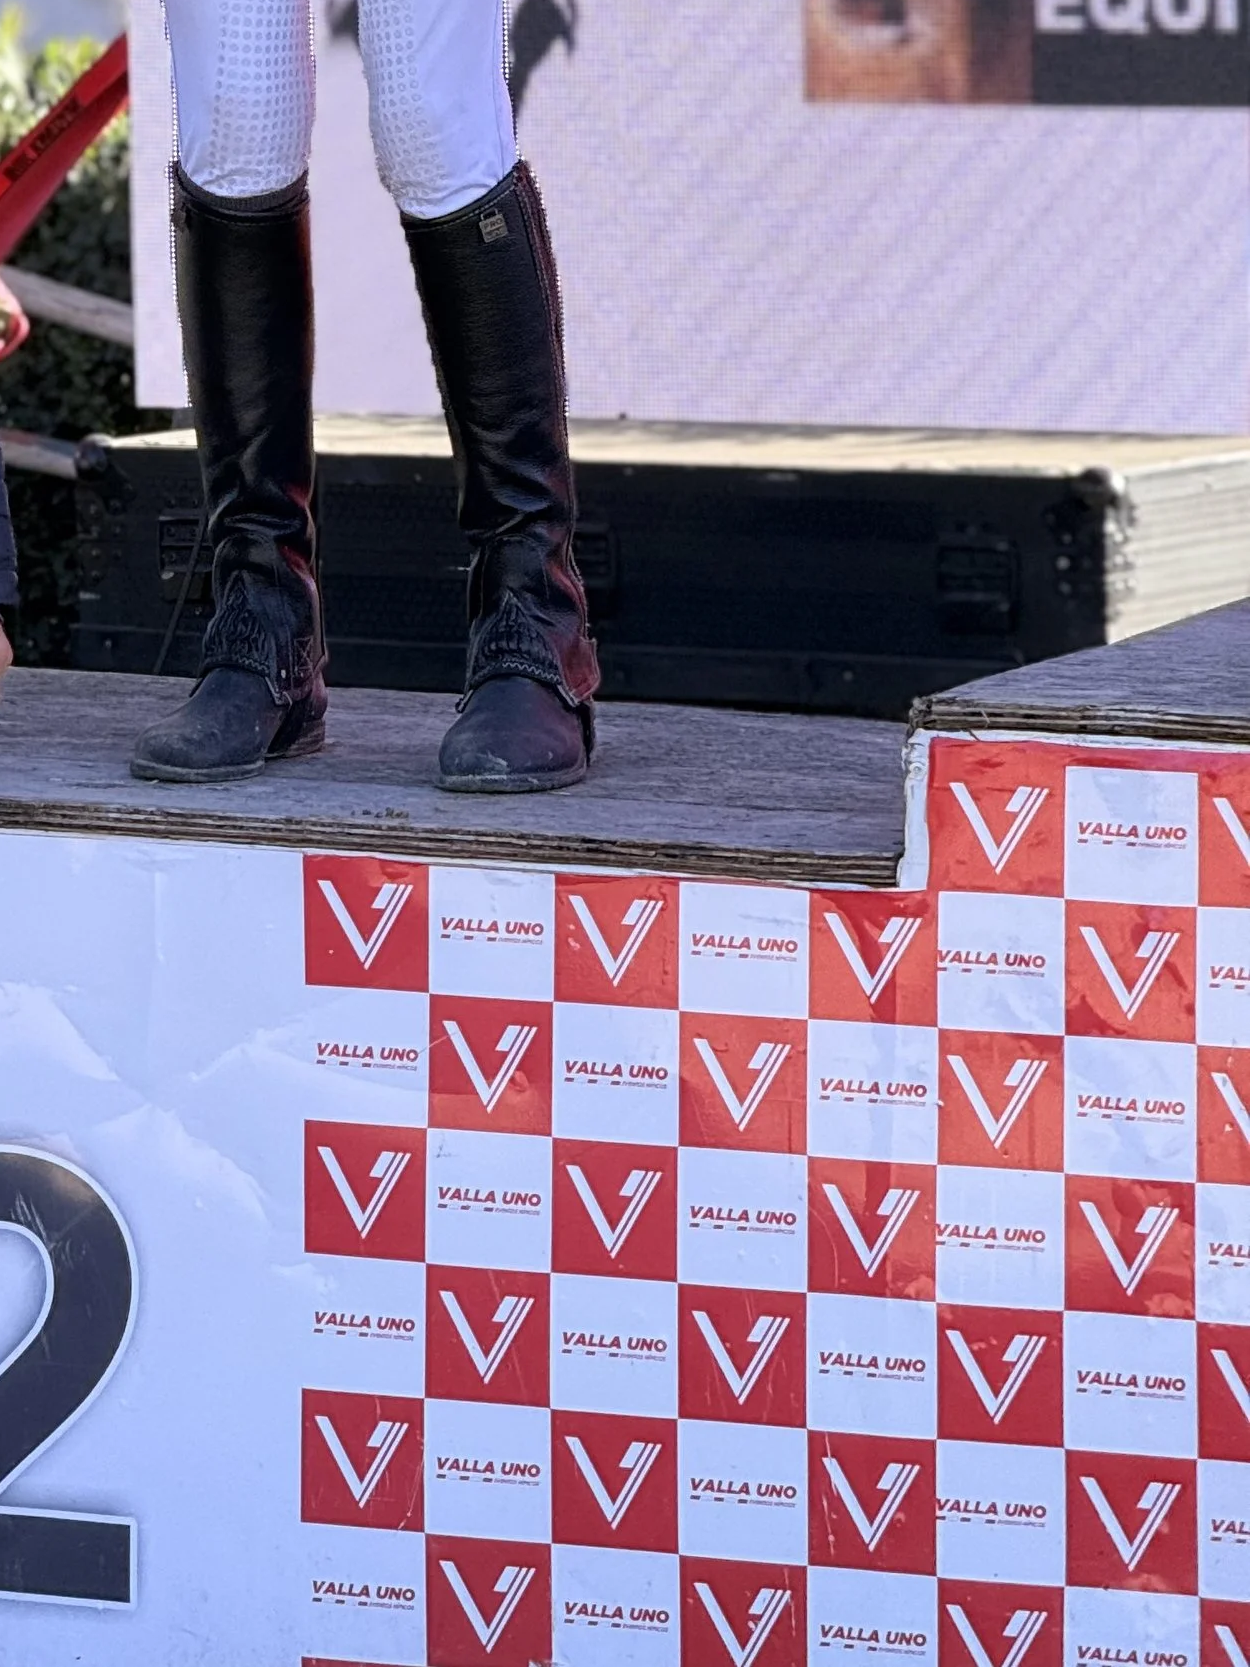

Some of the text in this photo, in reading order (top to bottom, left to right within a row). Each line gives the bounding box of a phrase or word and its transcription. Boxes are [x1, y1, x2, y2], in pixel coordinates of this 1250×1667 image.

[1079, 822, 1187, 840] VALLA UNO
[442, 917, 544, 936] VALLA UNO
[692, 934, 798, 953] VALLA UNO
[1005, 953, 1046, 968] UNO
[1210, 966, 1250, 981] VAL
[317, 1043, 419, 1062] VALLA UNO
[565, 1060, 668, 1080] VALLA UNO
[820, 1078, 927, 1097] VALLA UNO
[1078, 1095, 1185, 1115] VALLA UNO
[438, 1187, 541, 1206] VALLA UNO
[690, 1206, 796, 1225] VALLA UNO
[1004, 1228, 1046, 1243] UNO
[1209, 1243, 1250, 1259] VAL
[315, 1311, 415, 1332] VALLA UNO
[563, 1332, 667, 1352] VALLA UNO
[820, 1352, 926, 1372] VALLA UNO
[1077, 1370, 1186, 1391] VALLA UNO
[437, 1457, 540, 1477] VALLA UNO
[691, 1478, 797, 1498] VALLA UNO
[1005, 1503, 1046, 1518] UNO
[1212, 1519, 1250, 1535] VAL
[313, 1580, 415, 1601] VALLA UNO
[565, 1602, 669, 1622] VALLA UNO
[821, 1625, 927, 1646] VALLA UNO
[1078, 1646, 1187, 1667] VALLA UNO
